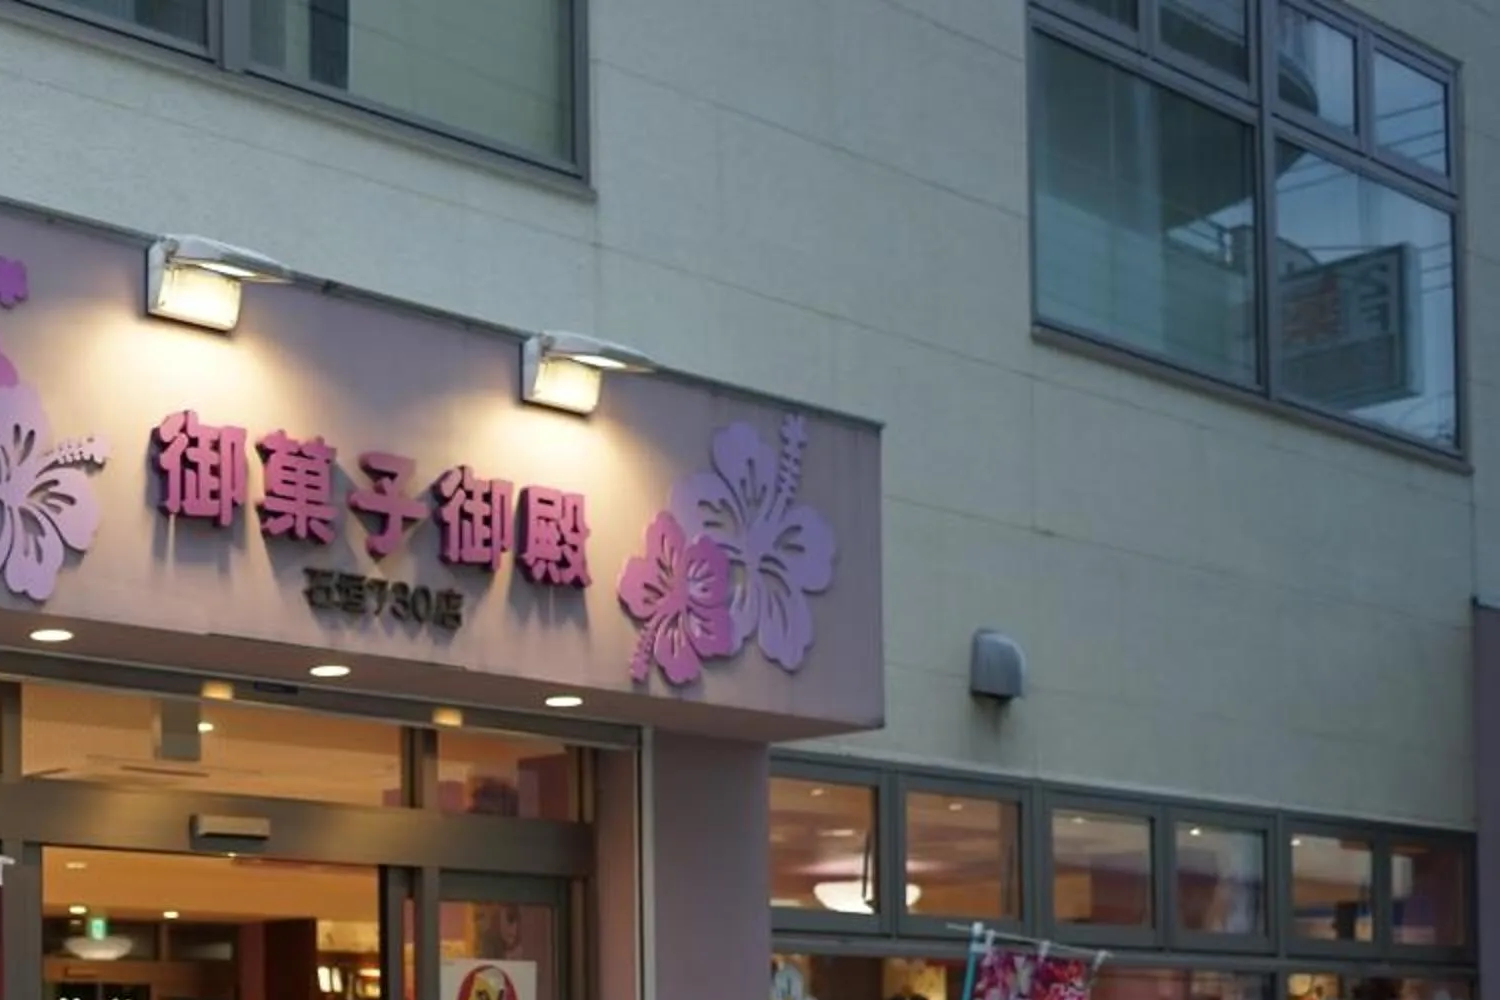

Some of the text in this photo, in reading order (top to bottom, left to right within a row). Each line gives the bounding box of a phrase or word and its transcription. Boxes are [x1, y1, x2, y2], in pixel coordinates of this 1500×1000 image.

[151, 408, 592, 588] 御菓子御殿
[303, 567, 463, 630] 石垣730店
